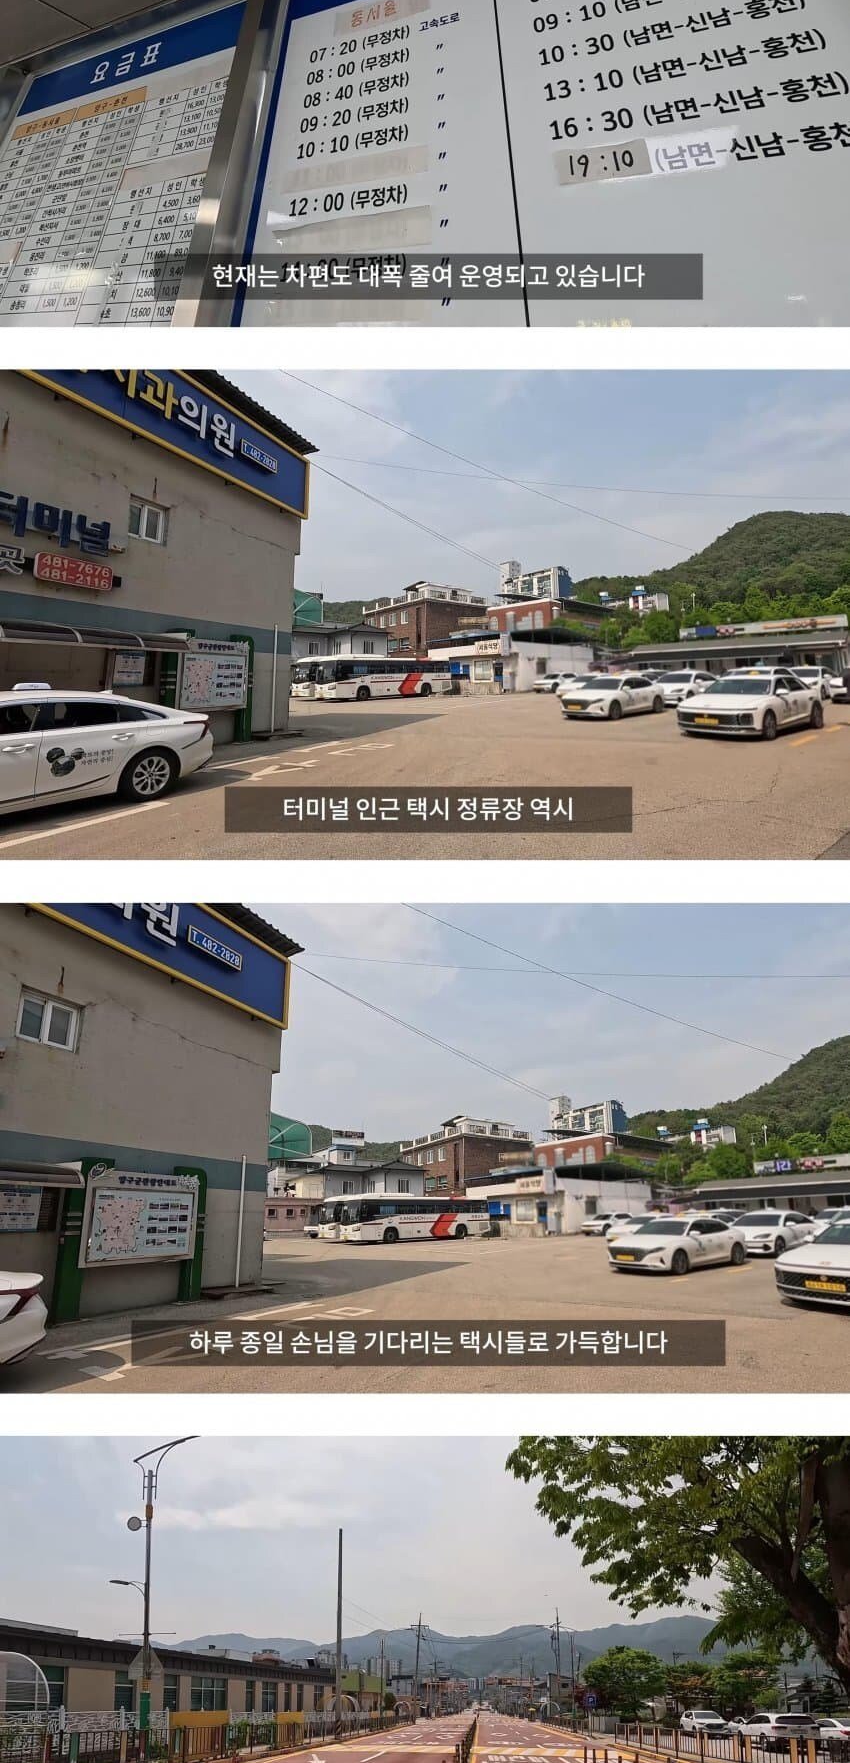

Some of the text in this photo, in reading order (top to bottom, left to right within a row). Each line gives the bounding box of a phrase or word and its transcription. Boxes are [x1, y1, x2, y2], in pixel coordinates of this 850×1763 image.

[362, 25, 410, 51] (무정차)
[418, 12, 460, 32] 고속도로
[632, 27, 827, 85] (남면-신남-홍천)
[643, 70, 850, 127] (남면-신남-홍천)
[355, 124, 410, 150] (무정차)
[350, 183, 408, 210] (무정차)
[40, 567, 109, 589] 481-2116
[42, 555, 110, 578] 481-7676
[202, 938, 241, 967] 482-2828
